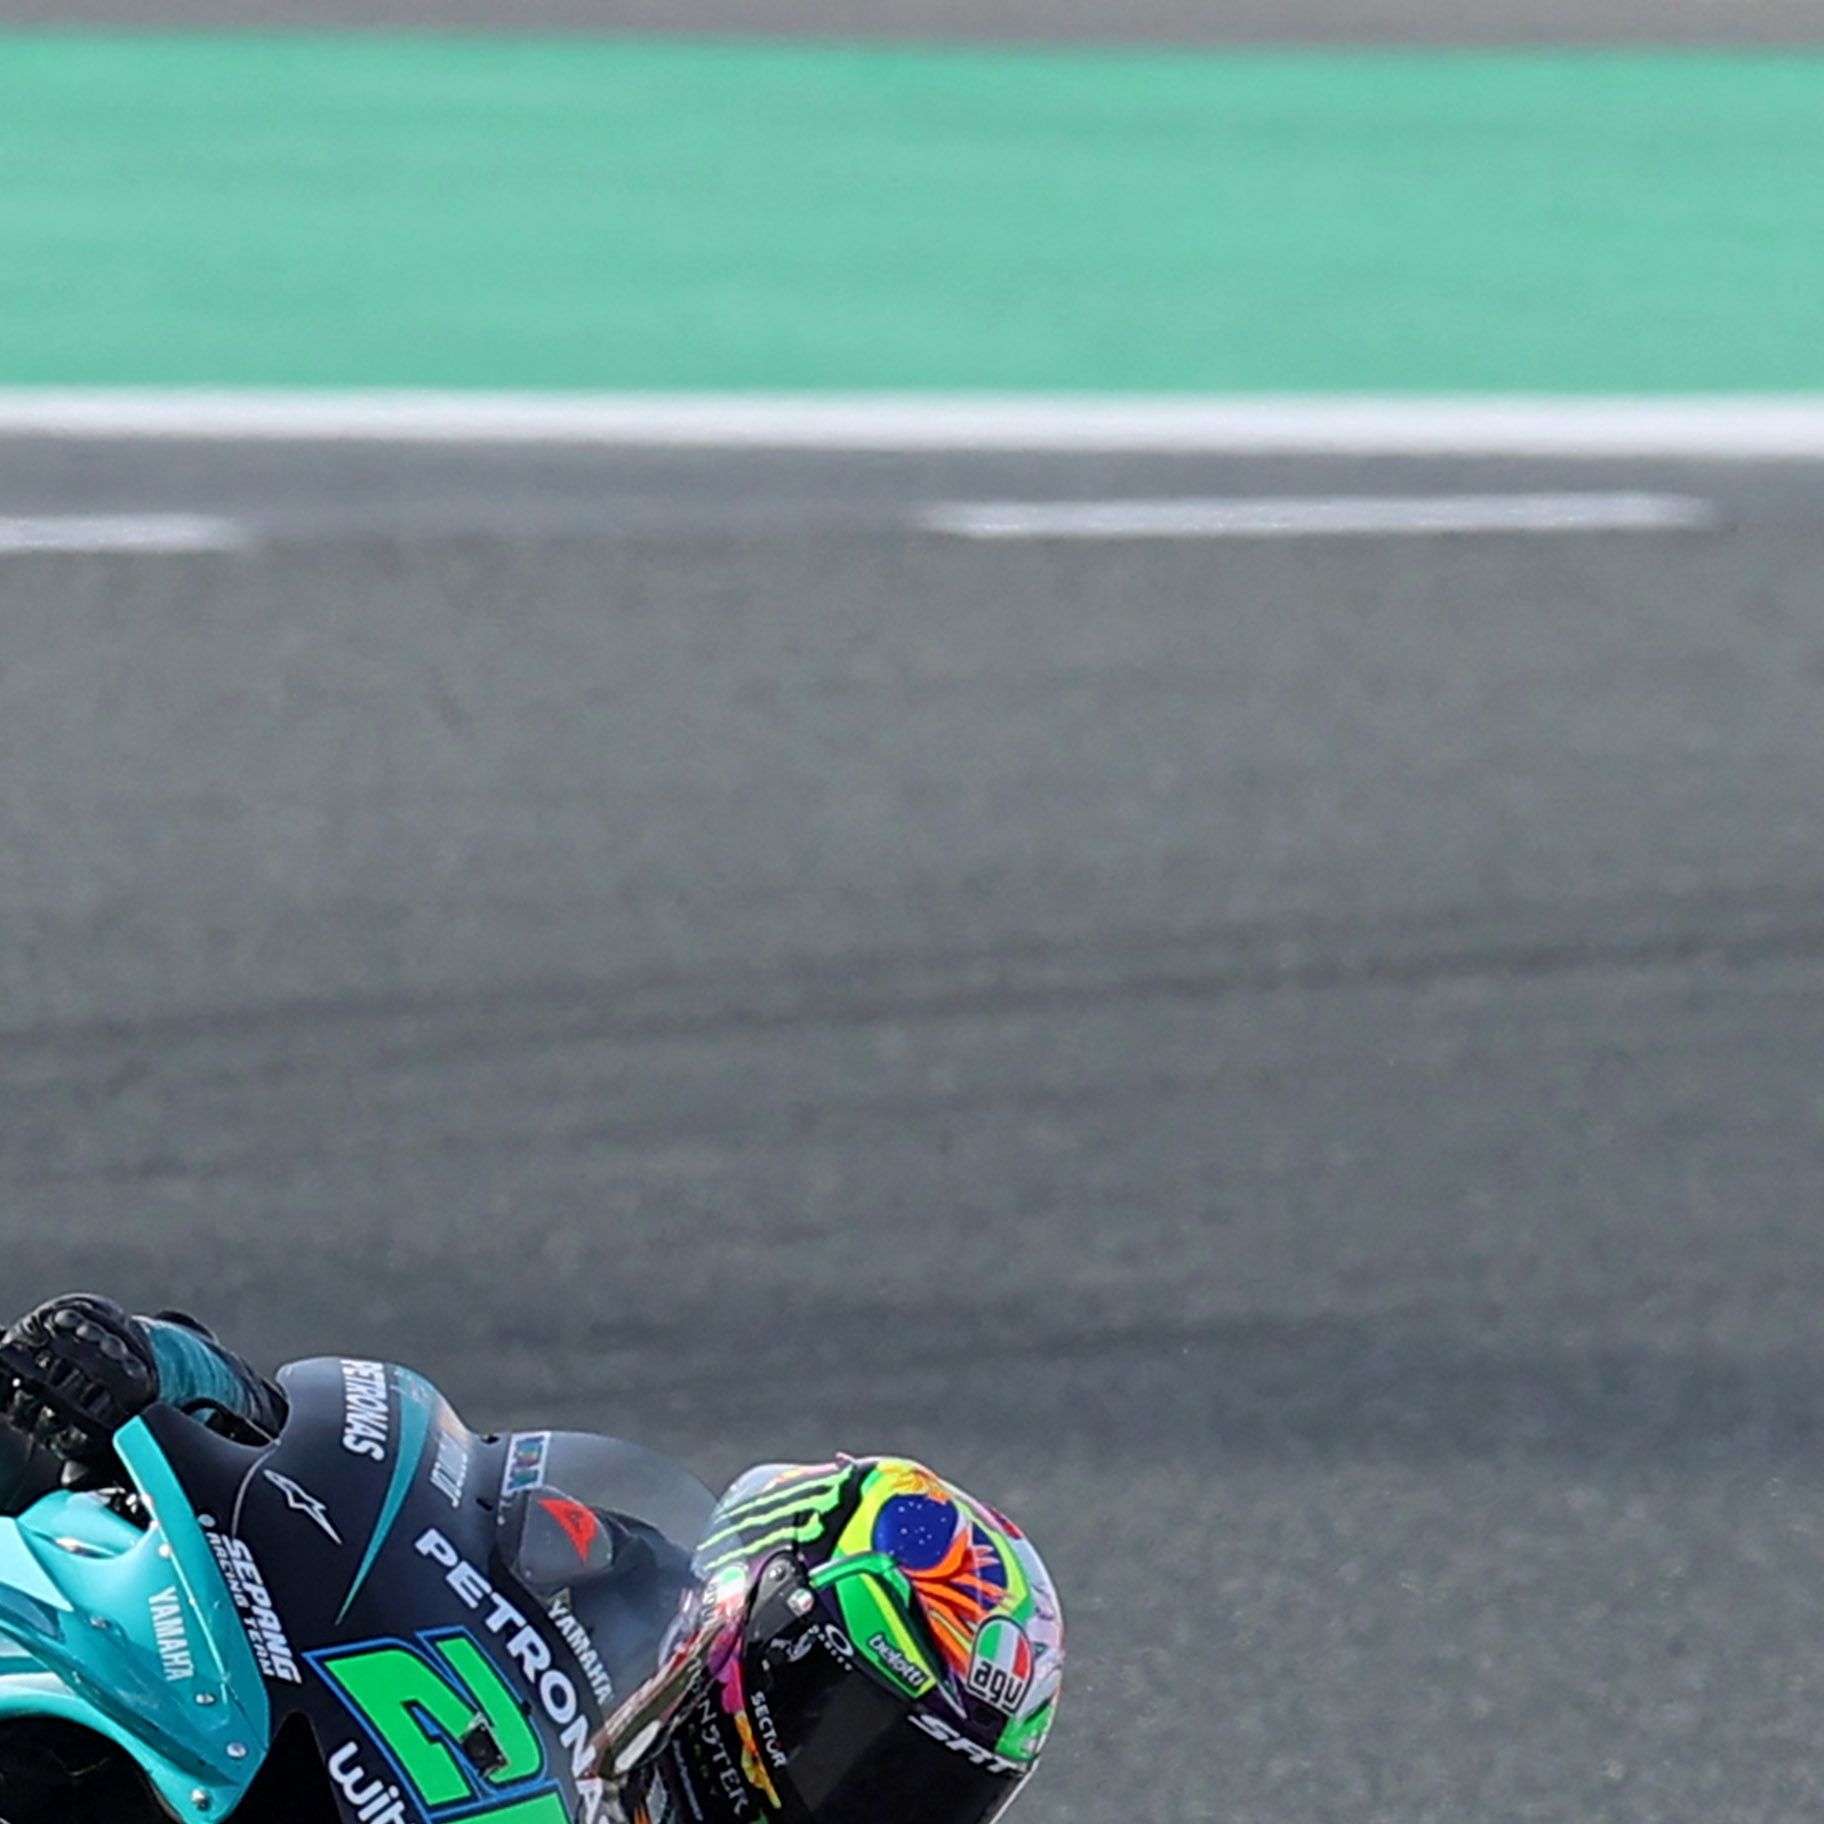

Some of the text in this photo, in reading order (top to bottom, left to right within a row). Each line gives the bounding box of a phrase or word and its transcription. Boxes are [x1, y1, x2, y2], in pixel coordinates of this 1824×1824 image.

[340, 1359, 389, 1461] PETRONAS
[148, 1586, 194, 1682] YAMAHA
[206, 1532, 274, 1676] RACING TEAM
[222, 1533, 302, 1684] SEPANG
[548, 1598, 614, 1705] YAMAHA
[974, 1660, 1023, 1708] agv
